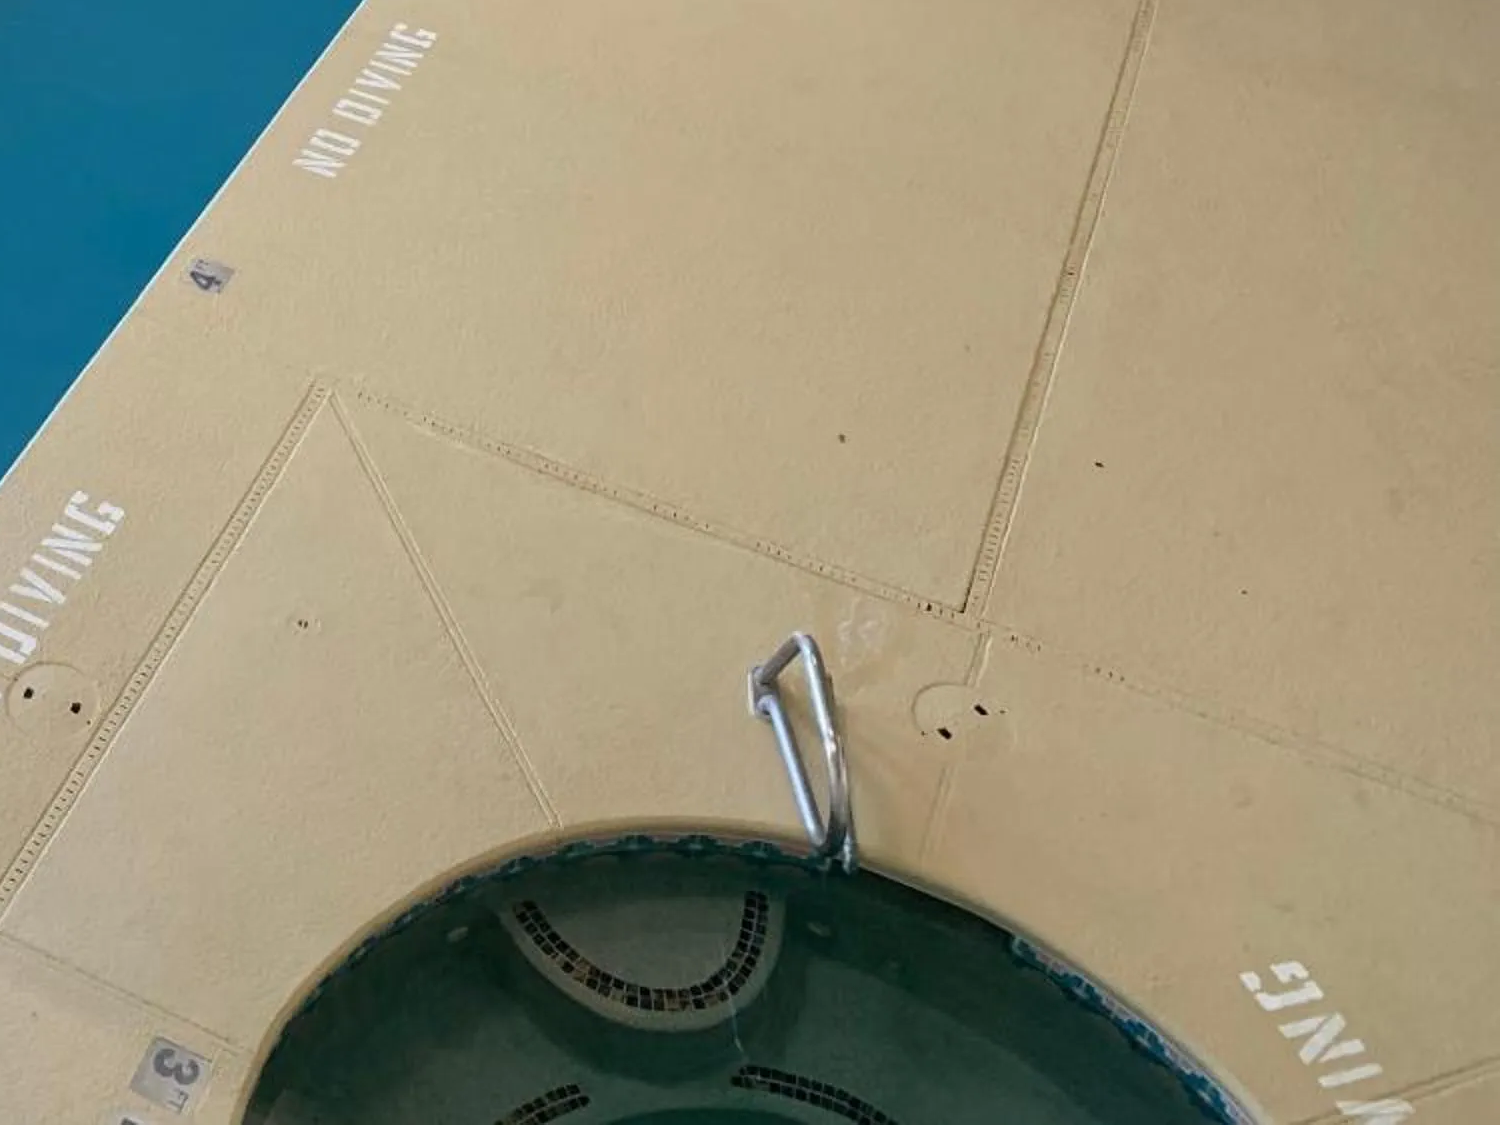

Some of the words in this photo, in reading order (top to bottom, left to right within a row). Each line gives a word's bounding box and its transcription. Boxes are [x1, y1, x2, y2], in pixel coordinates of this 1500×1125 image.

[292, 128, 362, 178] NO
[332, 23, 437, 125] DIVING
[153, 1048, 200, 1086] 3
